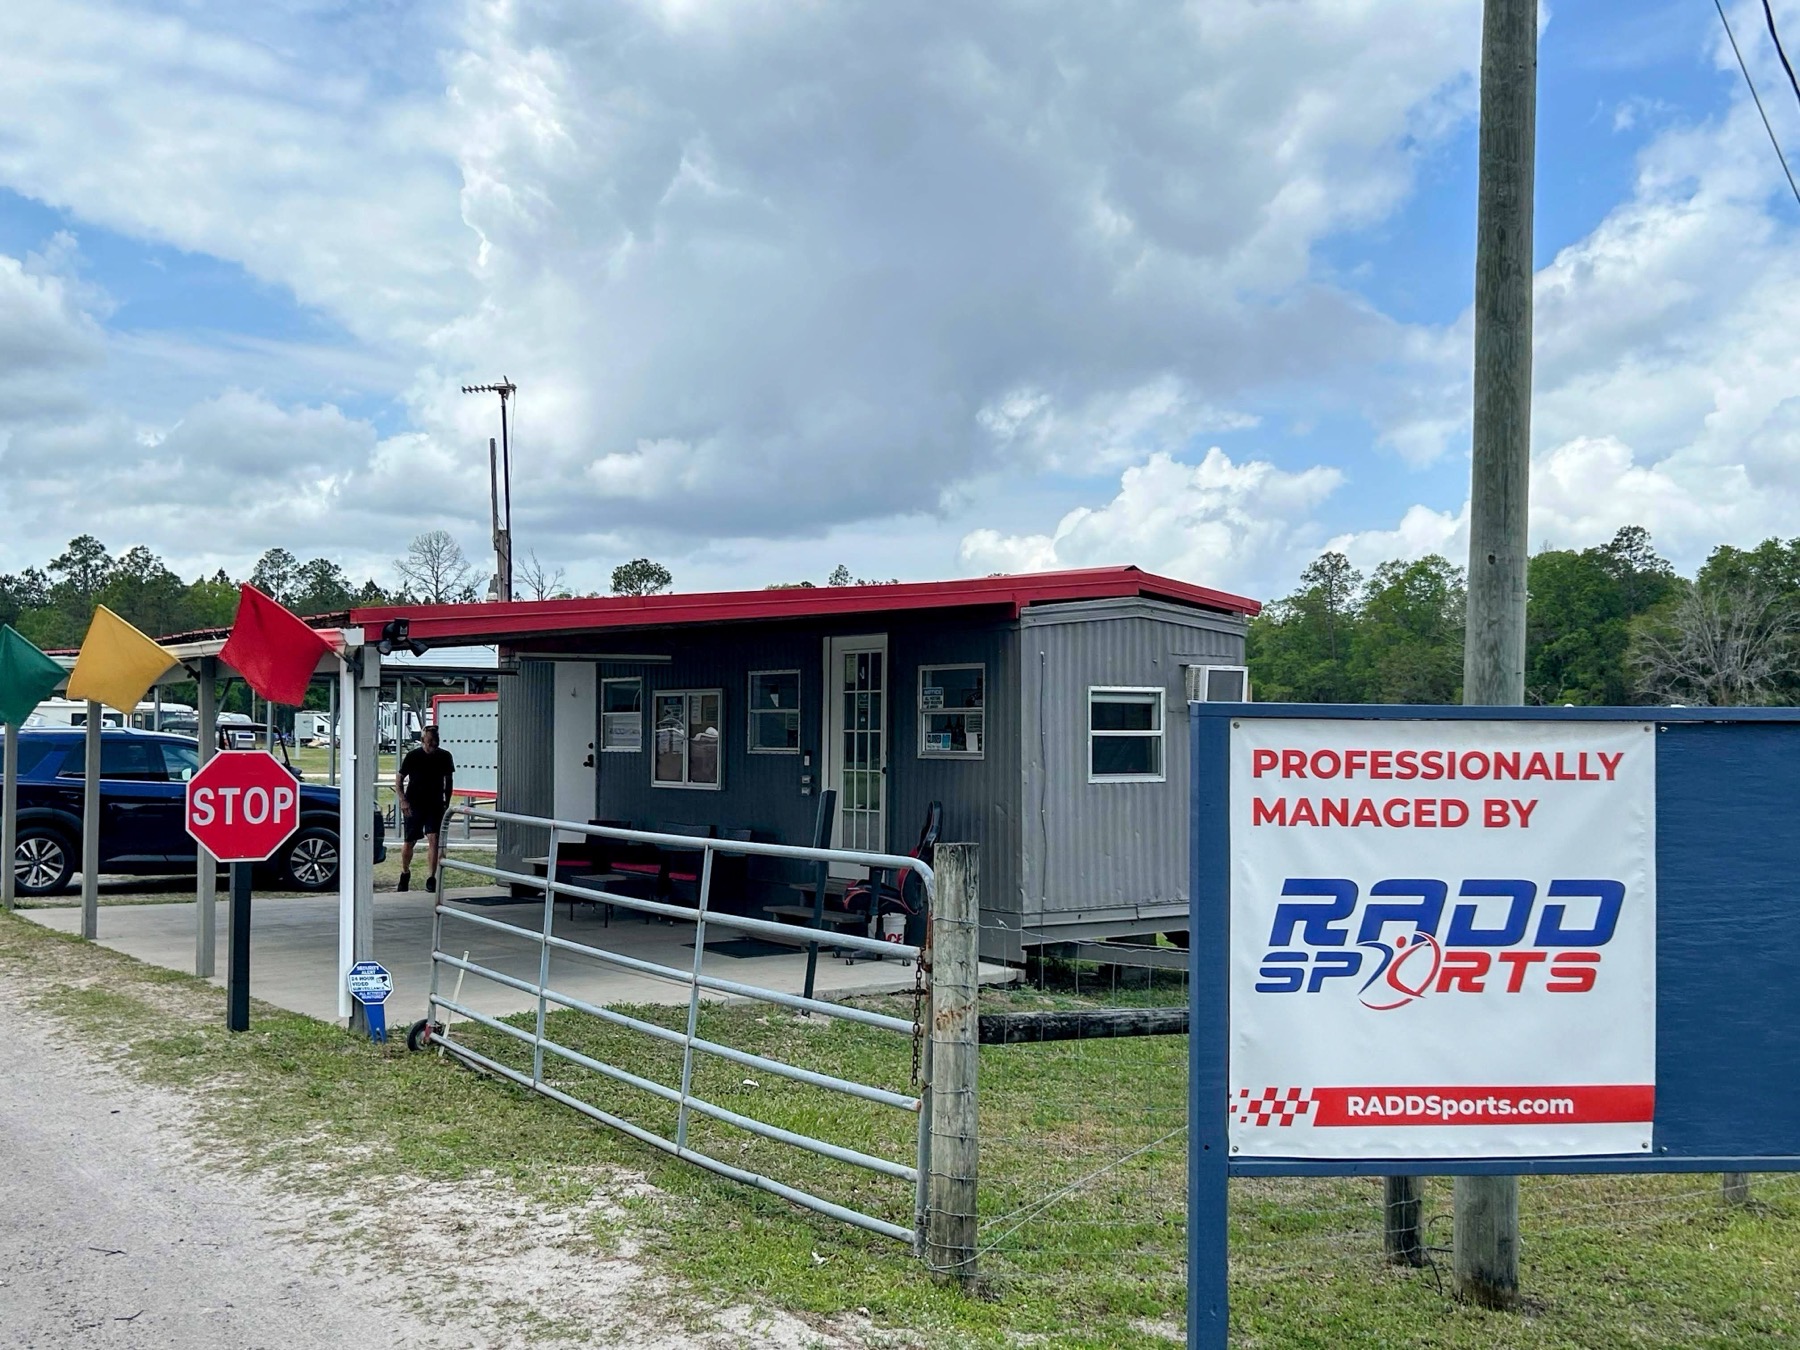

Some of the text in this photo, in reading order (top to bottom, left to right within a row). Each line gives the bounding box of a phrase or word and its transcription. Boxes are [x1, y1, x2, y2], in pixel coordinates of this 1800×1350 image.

[1251, 749, 1624, 781] PROFESSIONALLY
[192, 786, 294, 826] STOP
[1251, 797, 1538, 828] MANAGED BY
[1267, 878, 1626, 948] RADD
[1255, 950, 1601, 998] SPORTS
[1346, 1096, 1574, 1120] RADDSports.com
